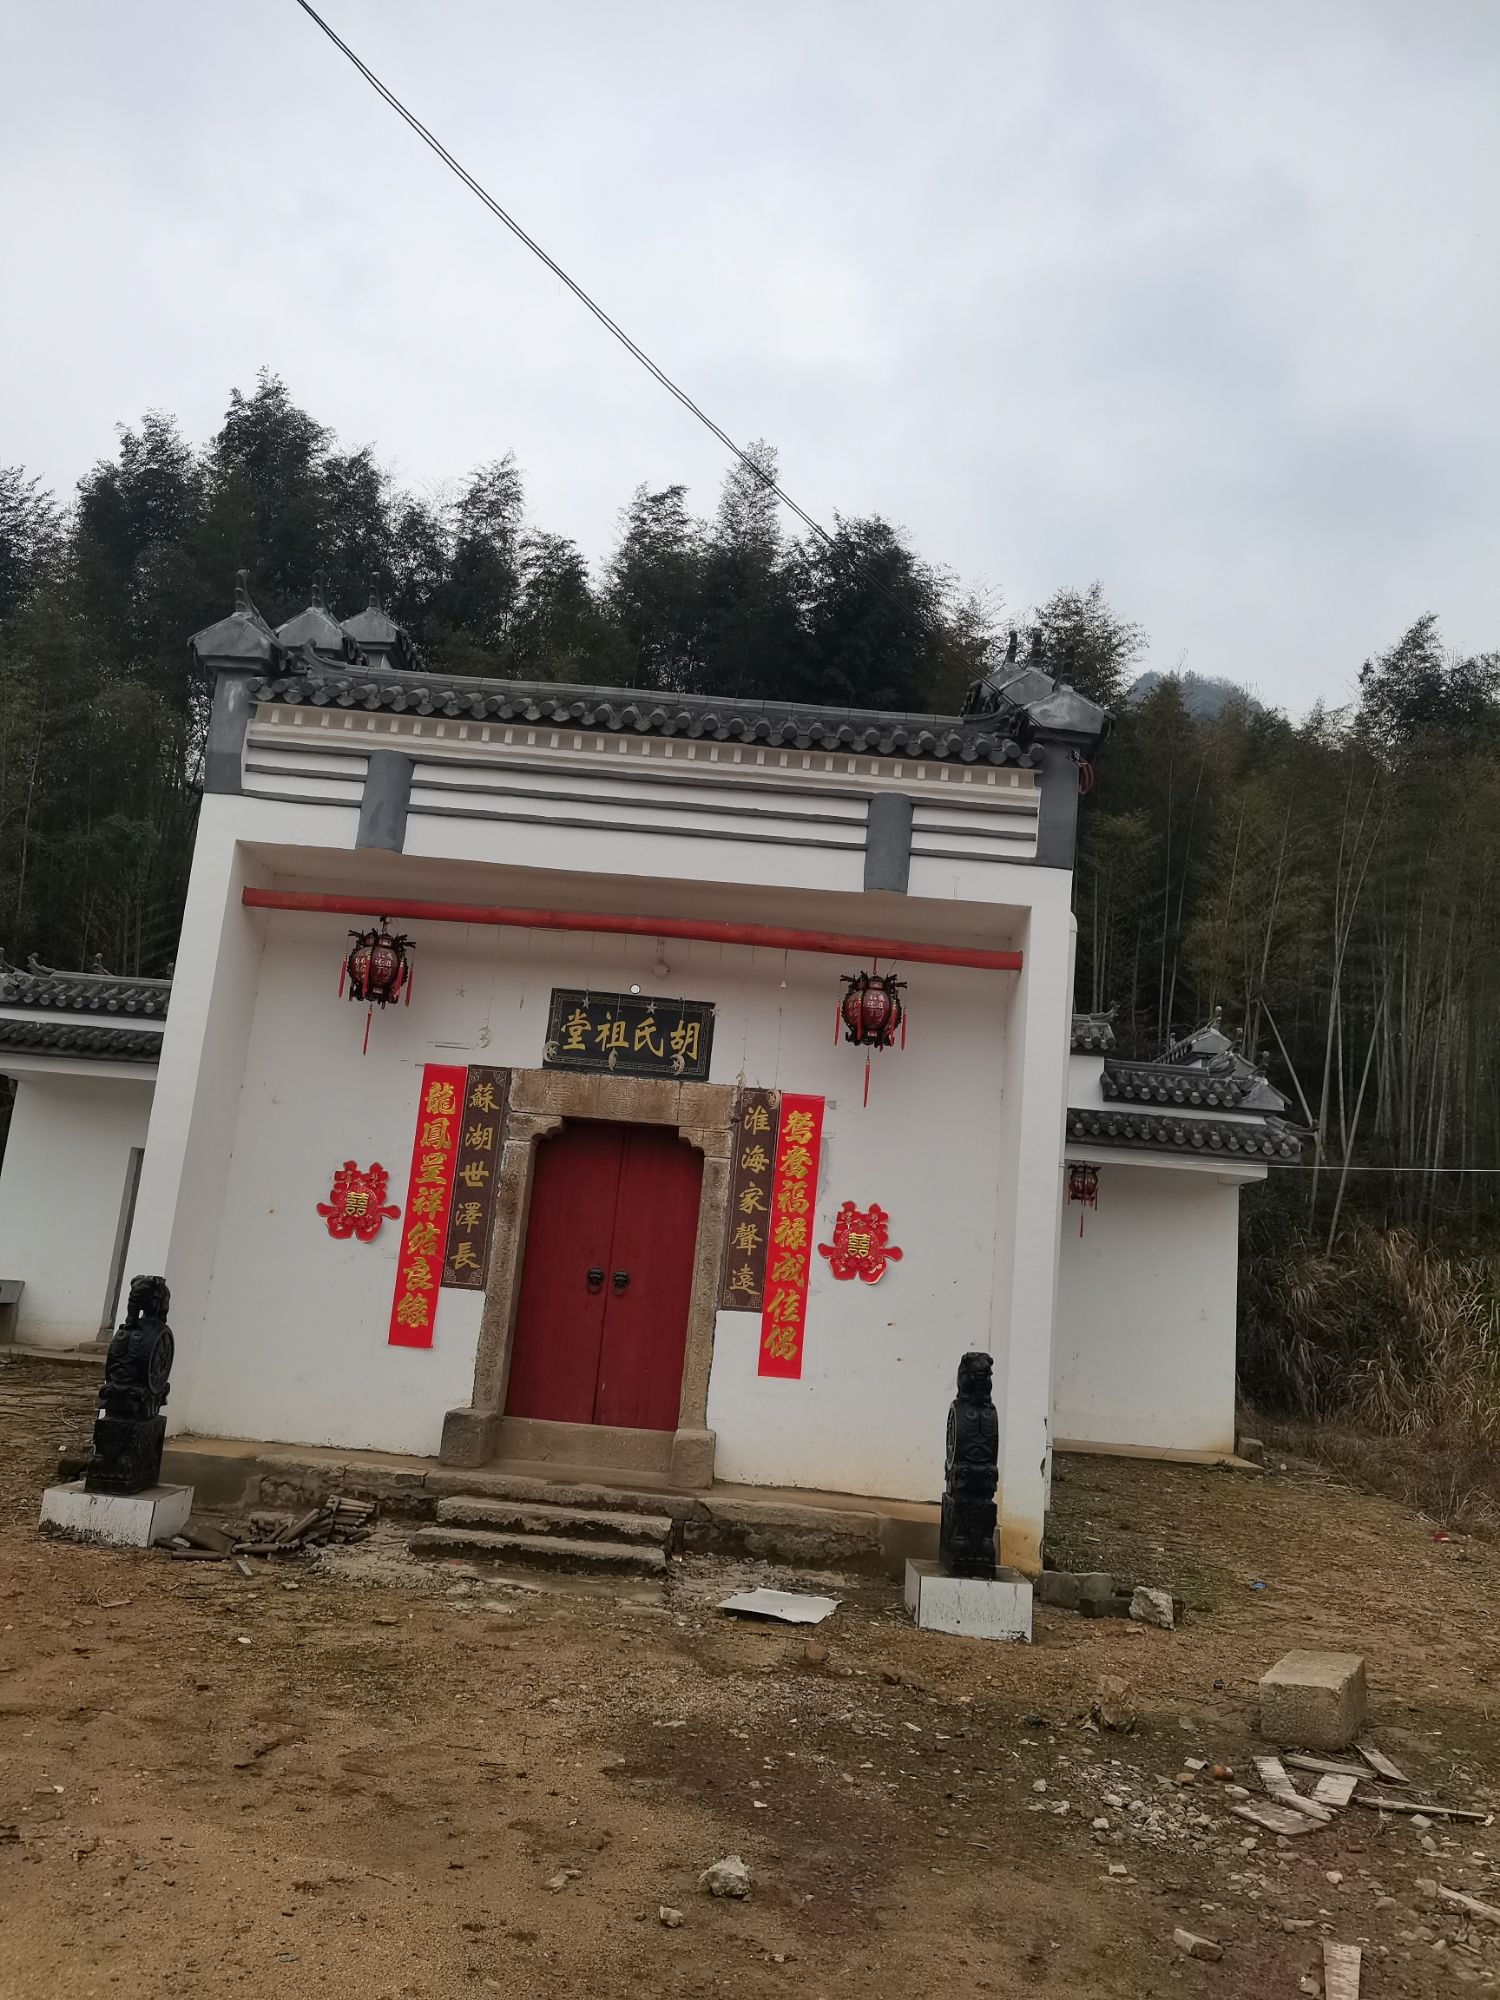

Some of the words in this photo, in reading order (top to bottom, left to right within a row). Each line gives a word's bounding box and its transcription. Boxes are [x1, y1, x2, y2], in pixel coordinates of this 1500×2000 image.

[450, 1083, 501, 1270] 蘇湖世澤長
[729, 1105, 771, 1295] 淮海家聲遠
